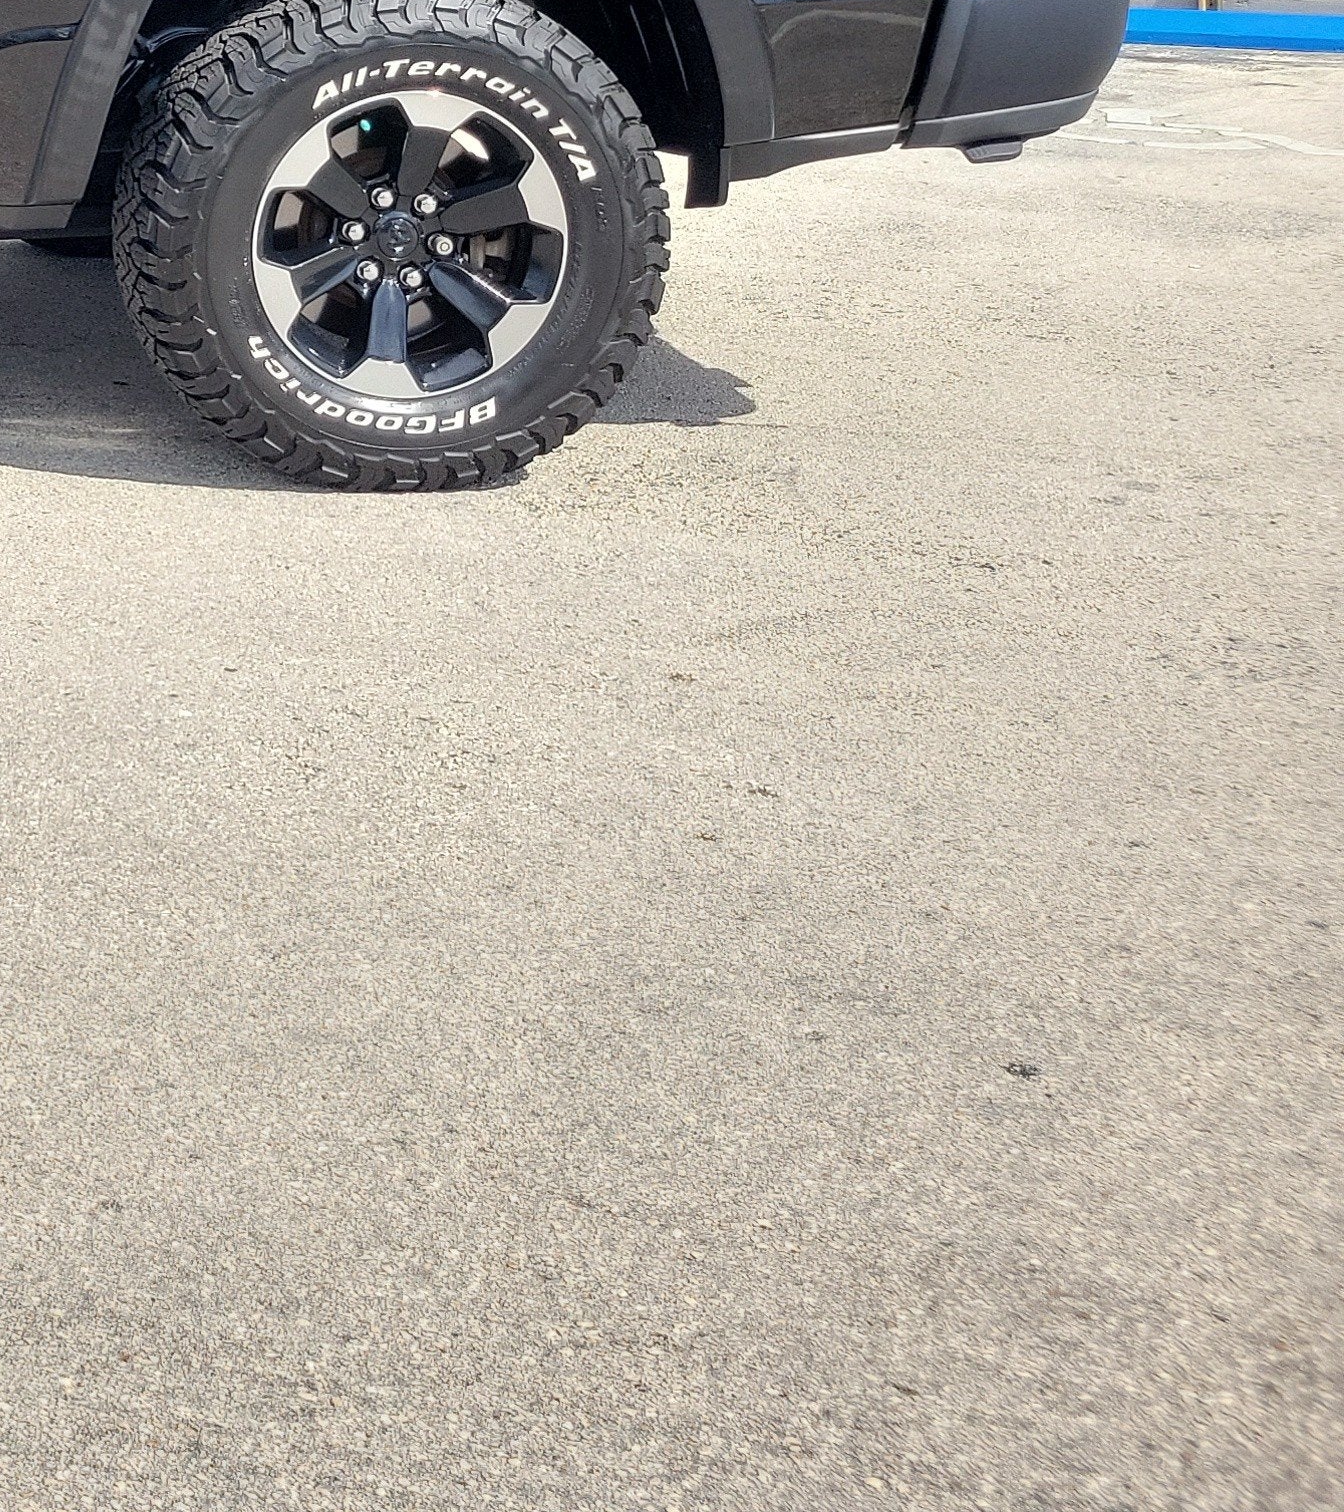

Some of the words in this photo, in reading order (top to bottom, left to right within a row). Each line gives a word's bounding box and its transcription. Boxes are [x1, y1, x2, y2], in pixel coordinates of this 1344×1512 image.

[312, 57, 550, 119] All-Terrain
[547, 119, 597, 182] T/A
[246, 335, 497, 436] BFGoodrich
